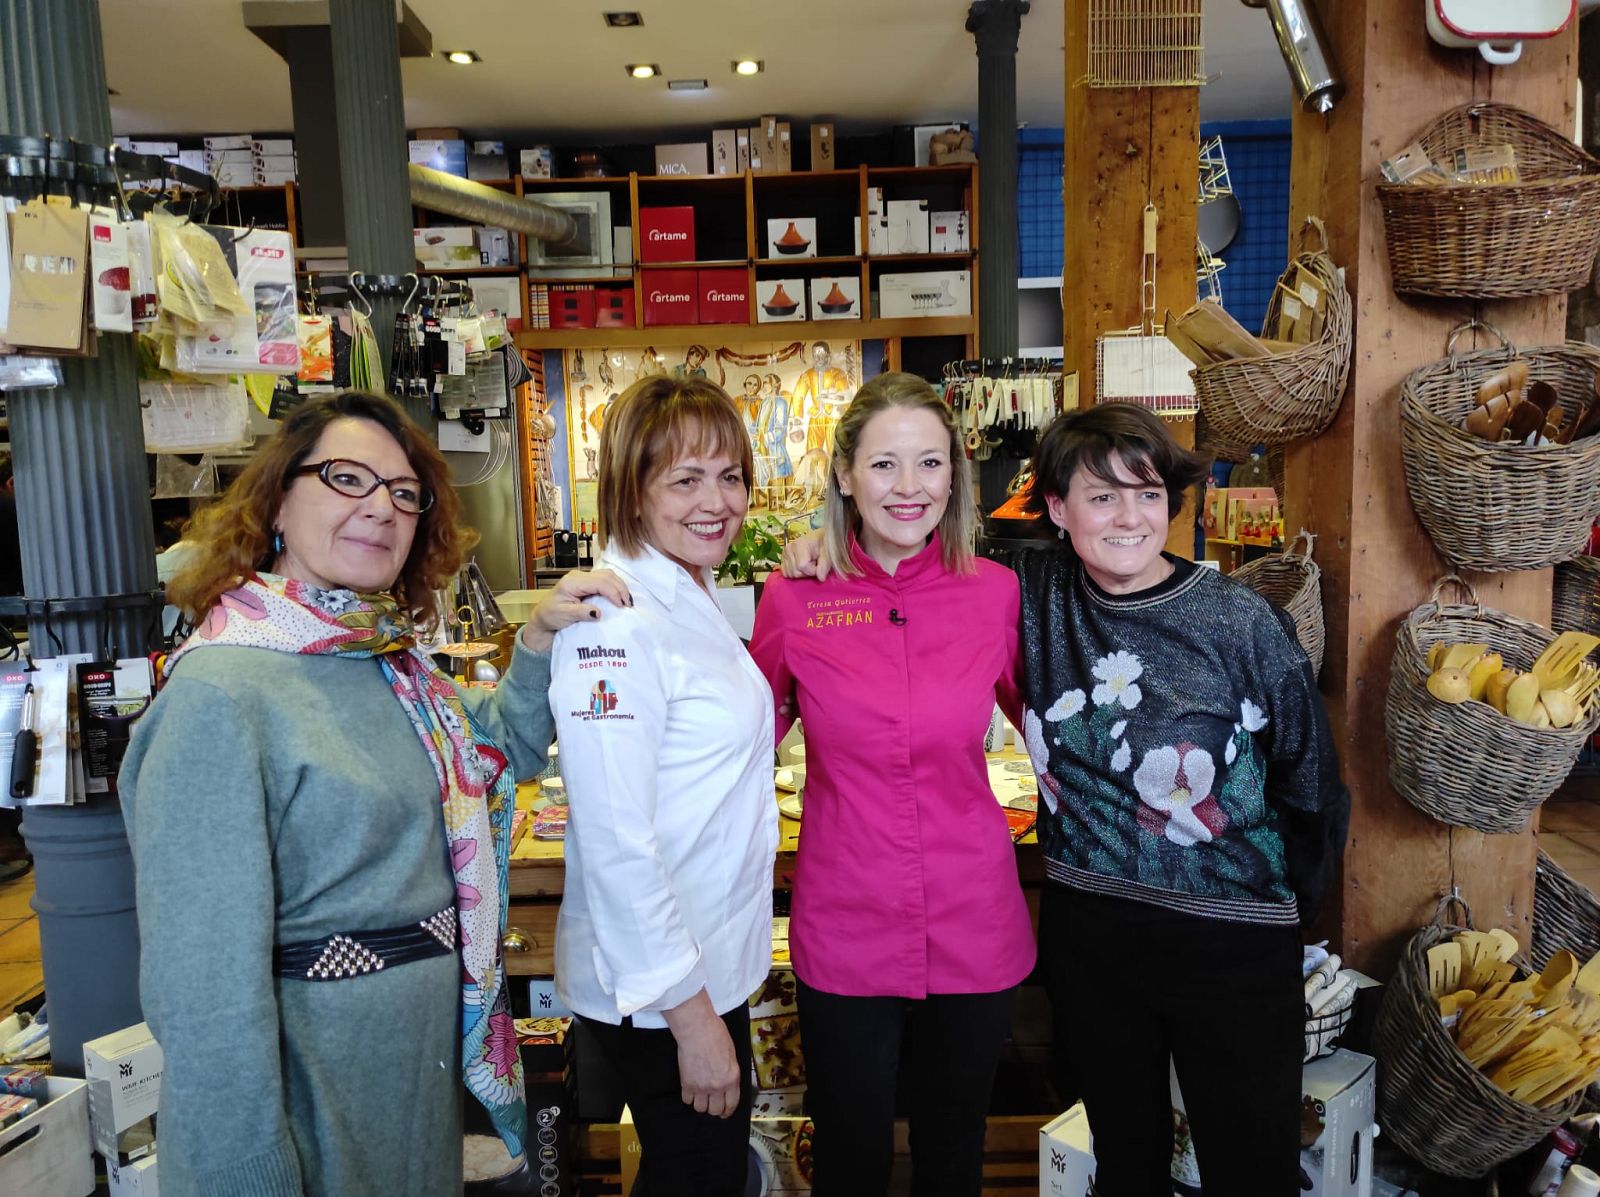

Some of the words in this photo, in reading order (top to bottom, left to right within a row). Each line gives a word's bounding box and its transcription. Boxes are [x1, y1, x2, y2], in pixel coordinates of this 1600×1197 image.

[576, 645, 626, 660] Mahou
[578, 661, 604, 670] DESDE
[607, 660, 627, 668] 1890
[87, 673, 105, 681] OXO
[571, 709, 594, 718] Mujeres
